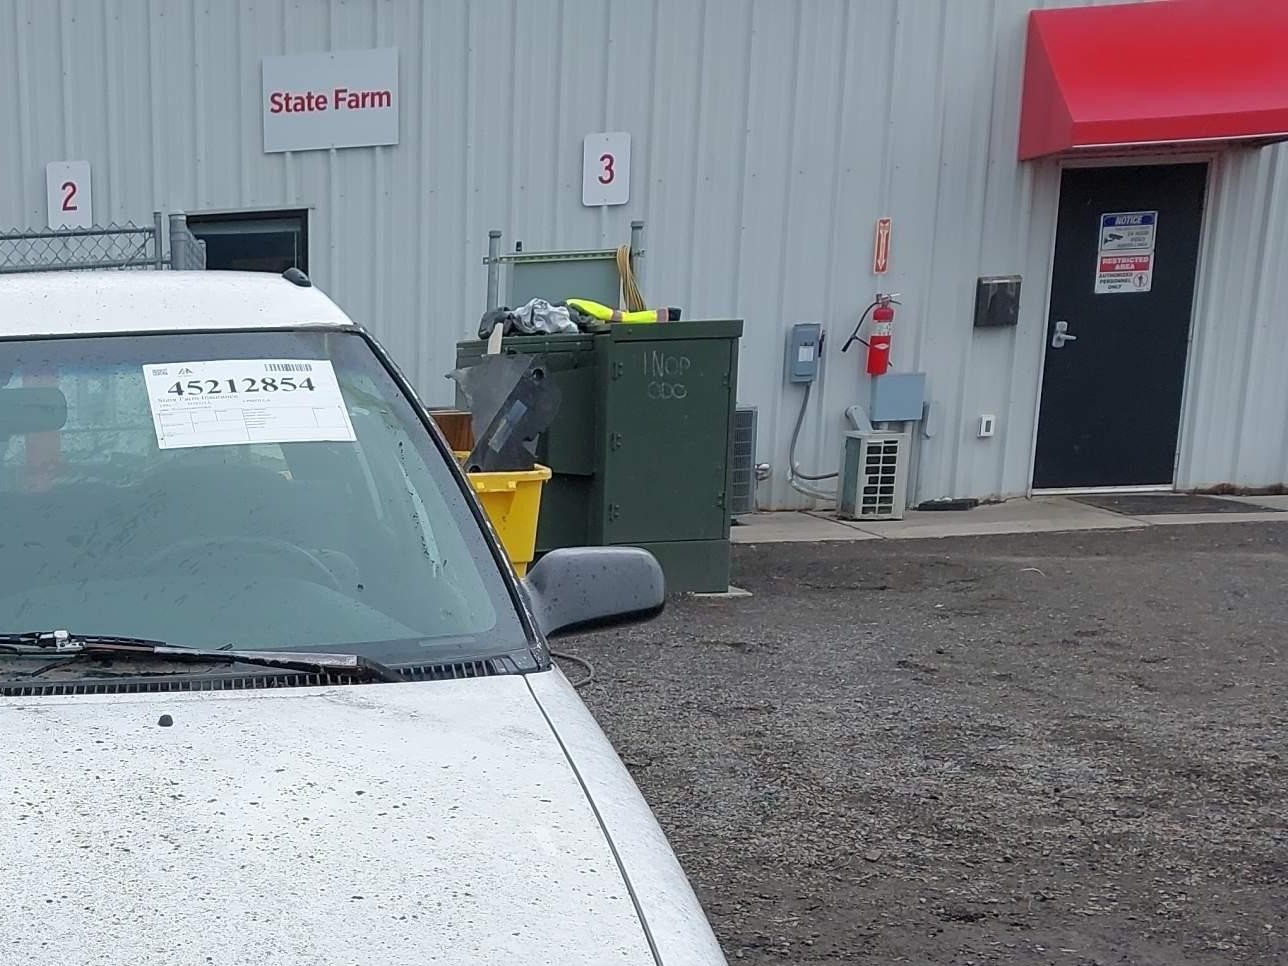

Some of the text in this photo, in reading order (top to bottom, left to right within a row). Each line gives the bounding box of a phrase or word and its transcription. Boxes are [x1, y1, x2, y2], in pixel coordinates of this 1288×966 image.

[270, 88, 392, 113] State Farm
[598, 153, 615, 185] 3
[61, 181, 78, 211] 2
[1115, 215, 1142, 224] NOTICE
[167, 377, 315, 396] 45212854
